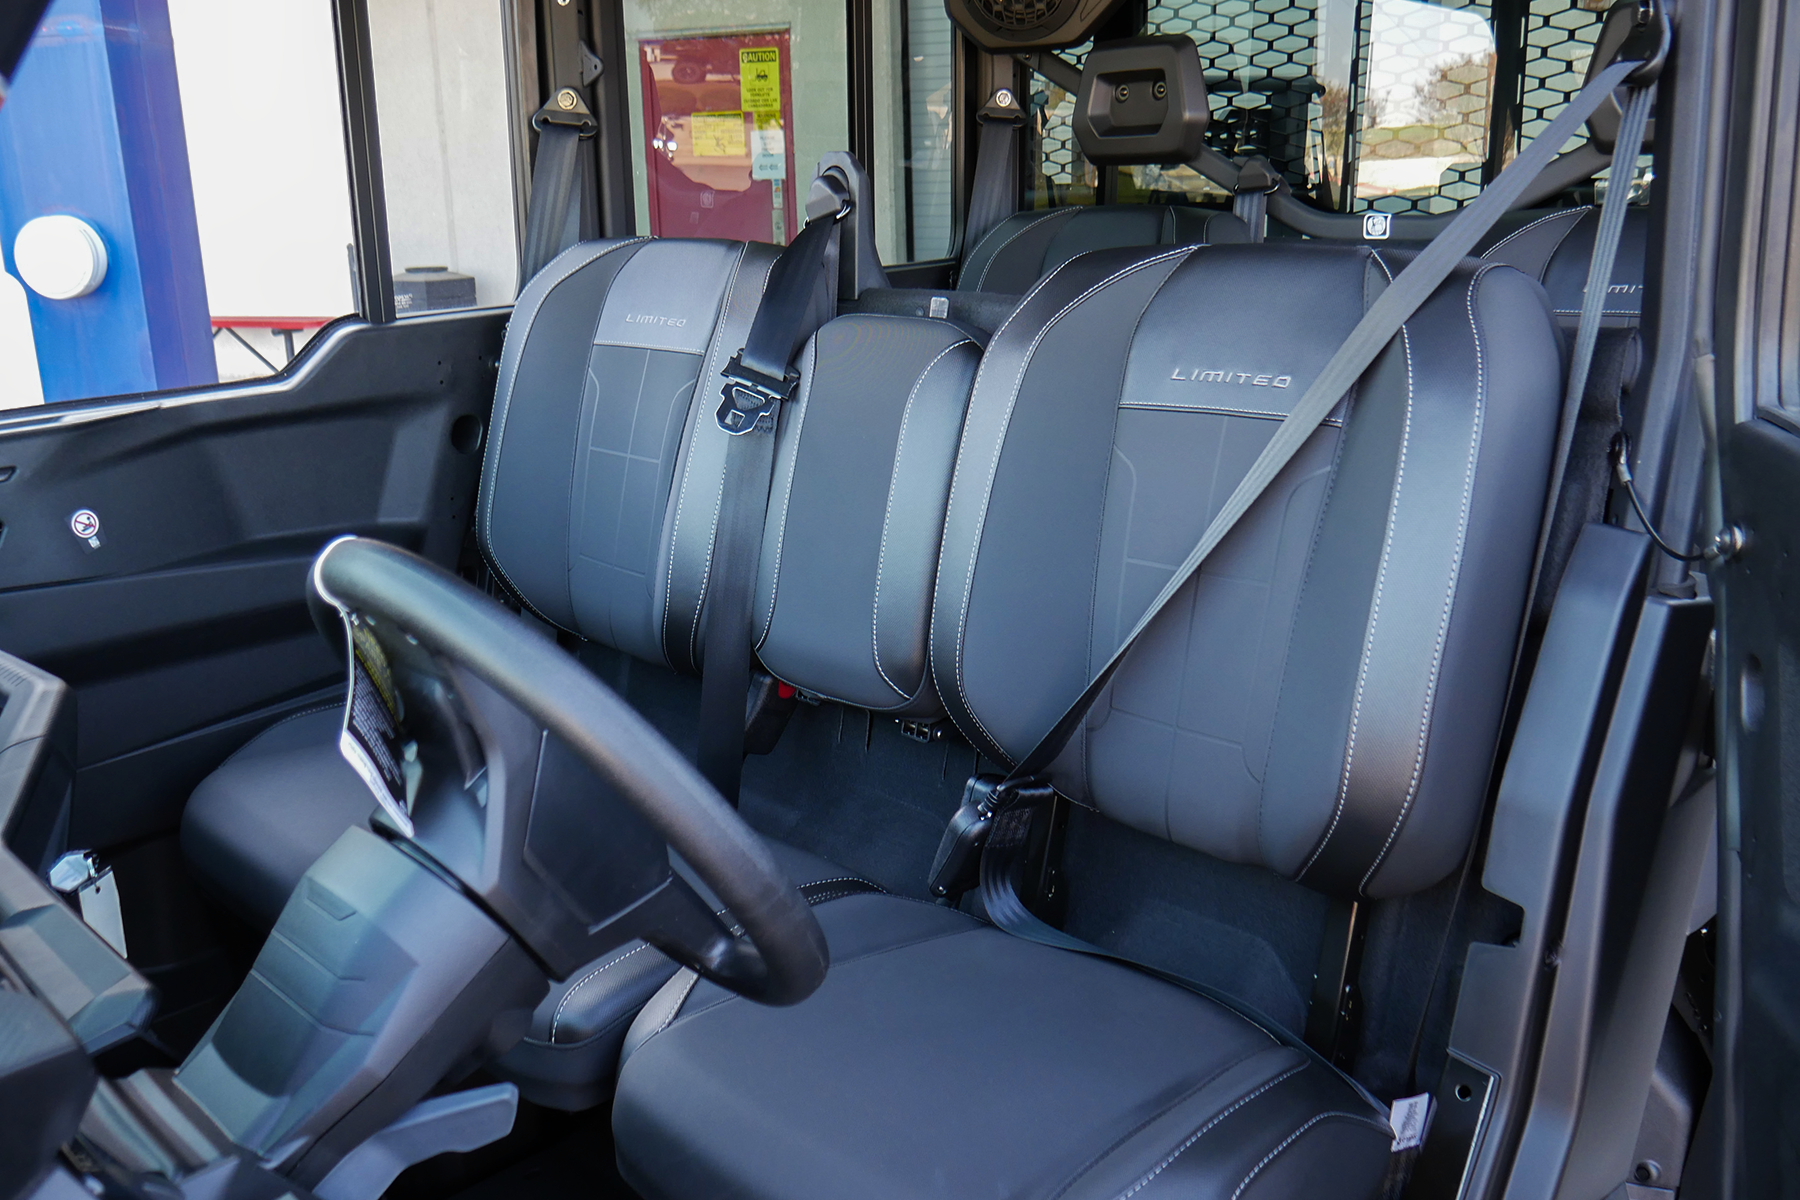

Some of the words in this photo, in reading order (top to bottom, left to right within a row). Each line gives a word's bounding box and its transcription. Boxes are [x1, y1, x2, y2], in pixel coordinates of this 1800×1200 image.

[742, 52, 776, 62] CAUTION
[625, 313, 687, 328] LIMITED
[1170, 368, 1292, 389] LIMITED
